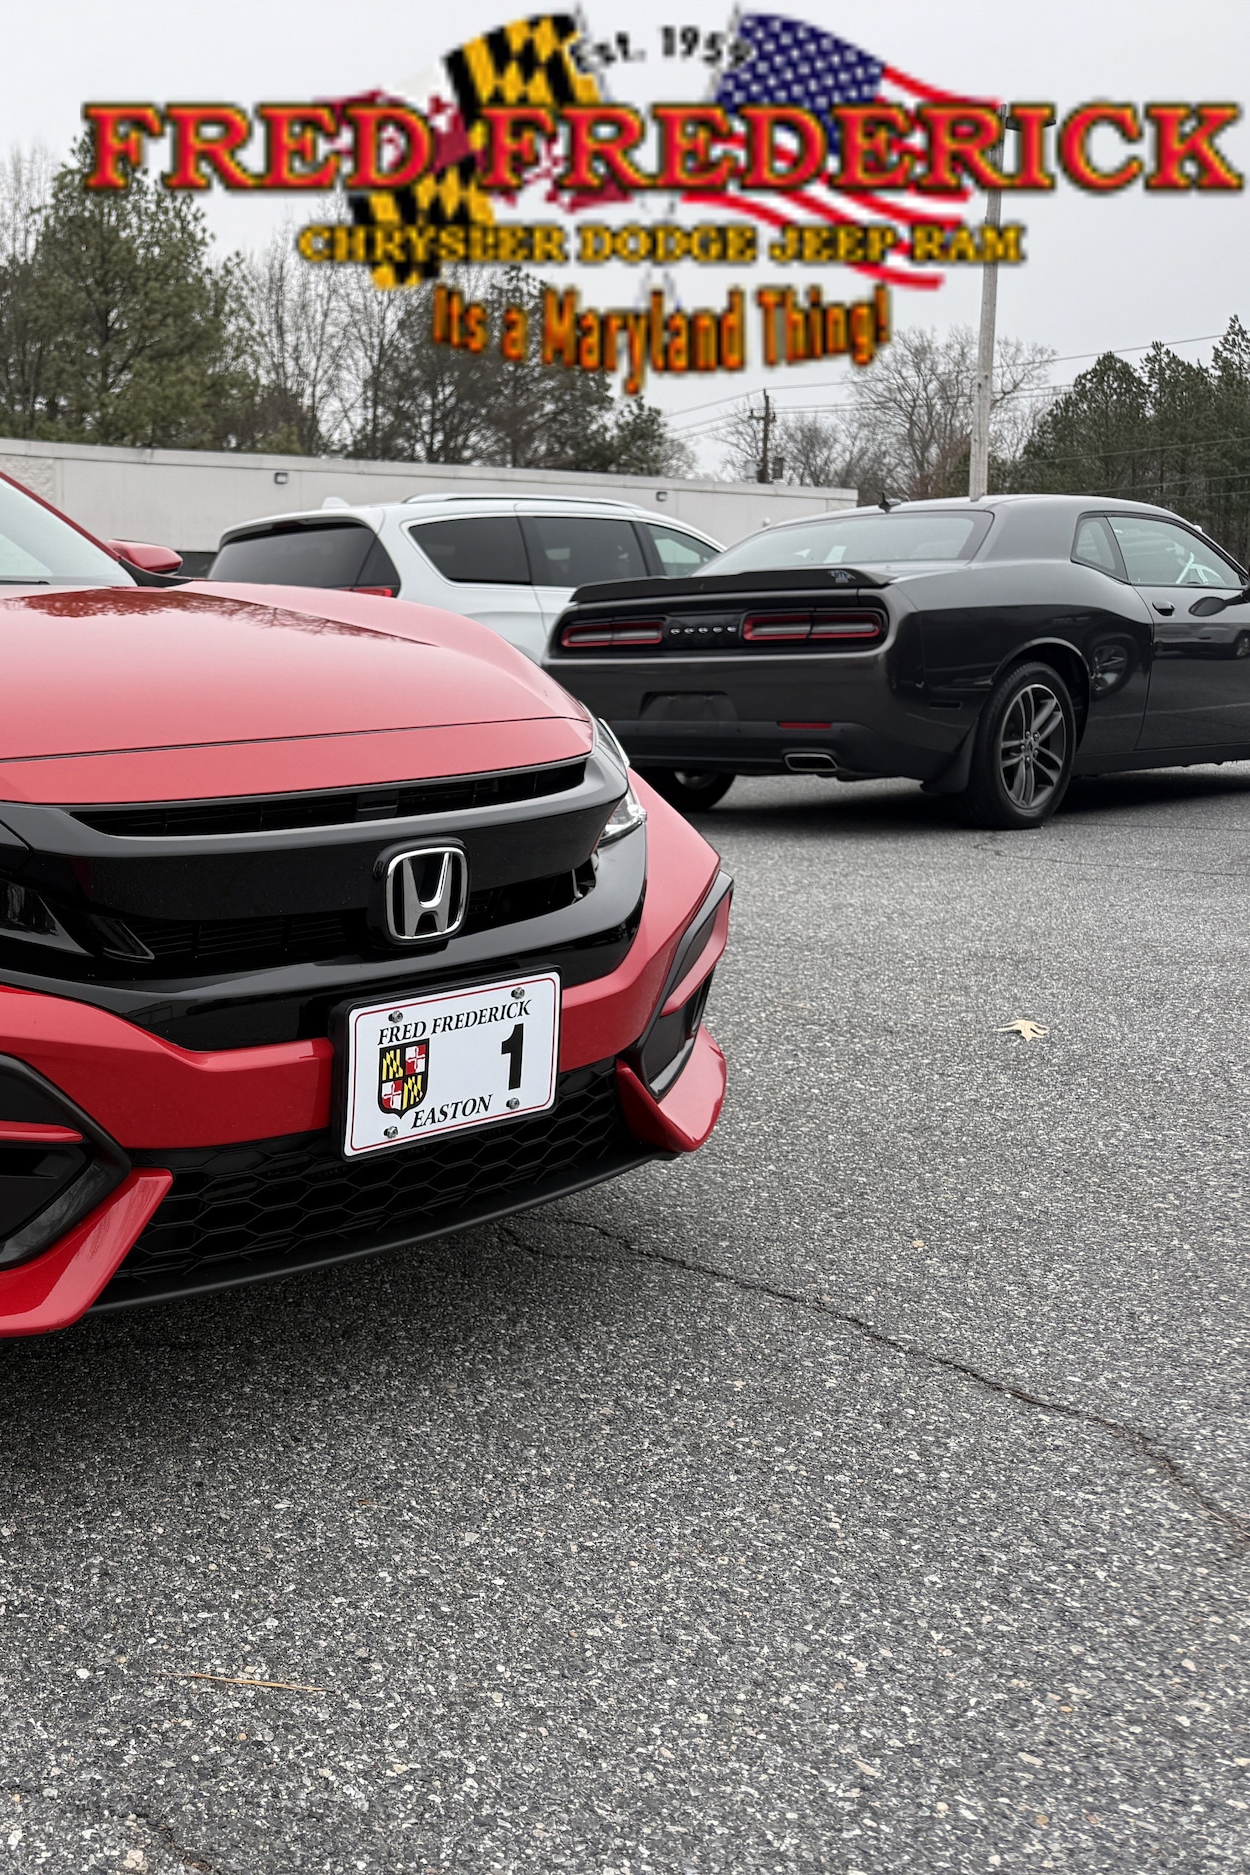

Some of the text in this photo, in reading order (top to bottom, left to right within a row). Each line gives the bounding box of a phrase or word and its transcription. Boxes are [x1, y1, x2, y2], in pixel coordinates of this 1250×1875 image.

[377, 999, 533, 1046] FRED FREDERICK
[500, 1022, 525, 1091] 1
[410, 1094, 493, 1129] EASTON
